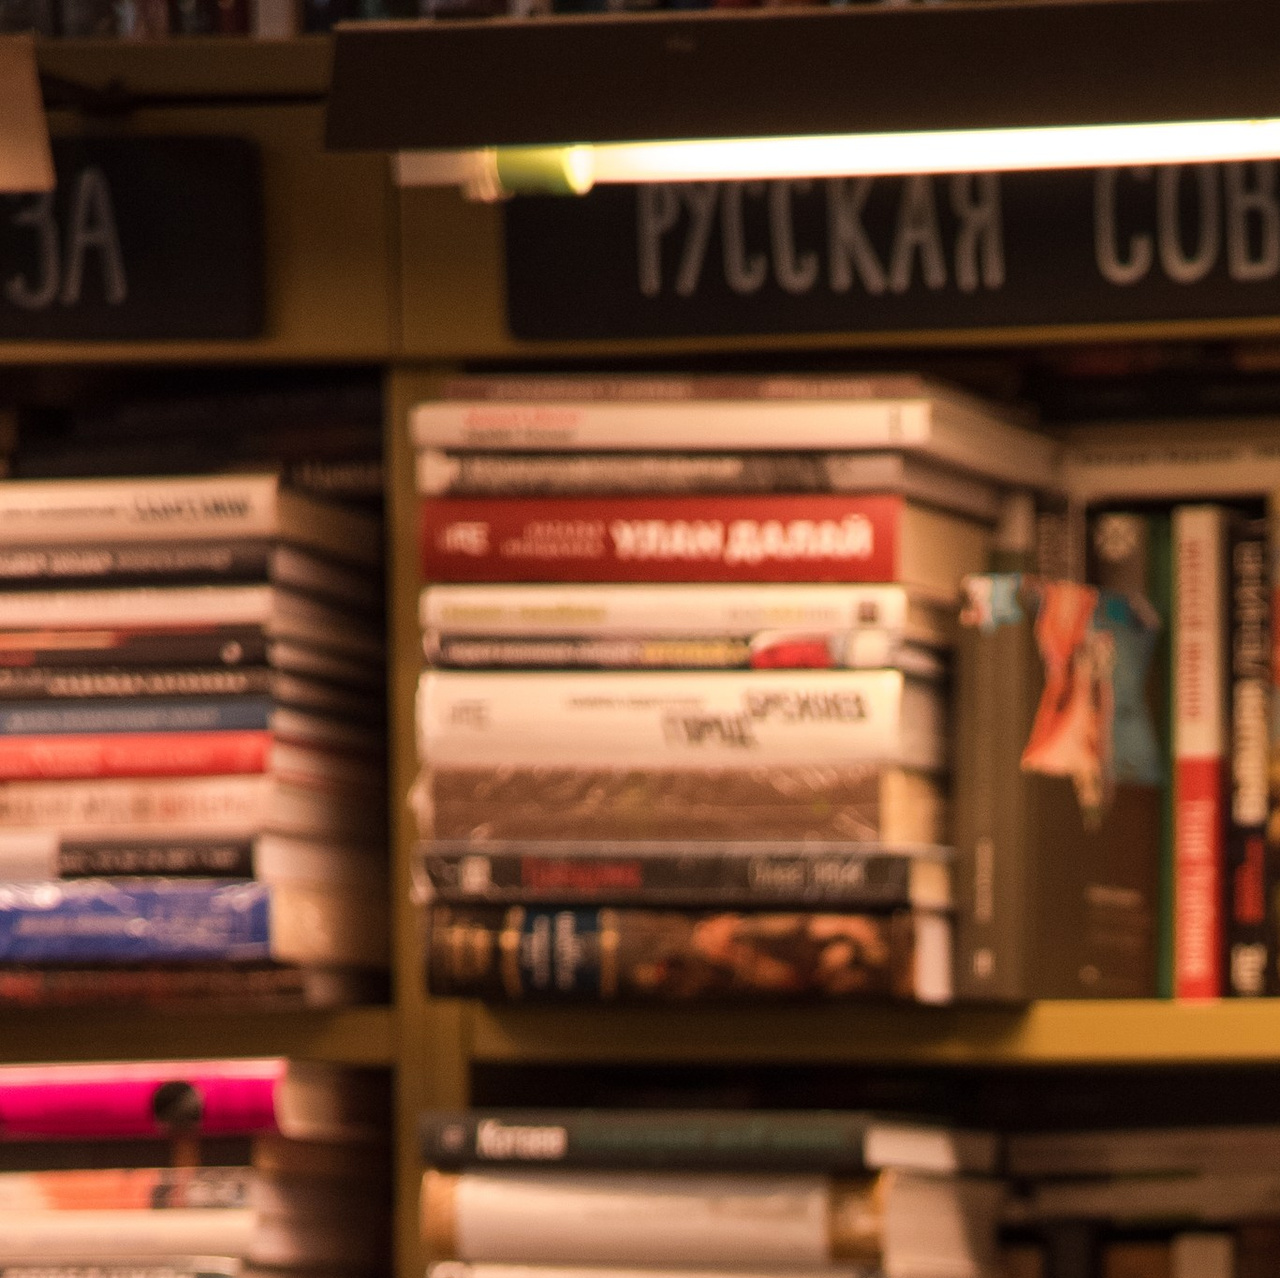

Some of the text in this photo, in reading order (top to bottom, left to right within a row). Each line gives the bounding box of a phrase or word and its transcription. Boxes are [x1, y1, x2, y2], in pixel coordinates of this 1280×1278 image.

[6, 164, 128, 311] ЗА
[636, 170, 1006, 297] РУССКАЯ
[613, 519, 722, 560] УЛАН
[726, 514, 873, 564] ДАЛАЙ
